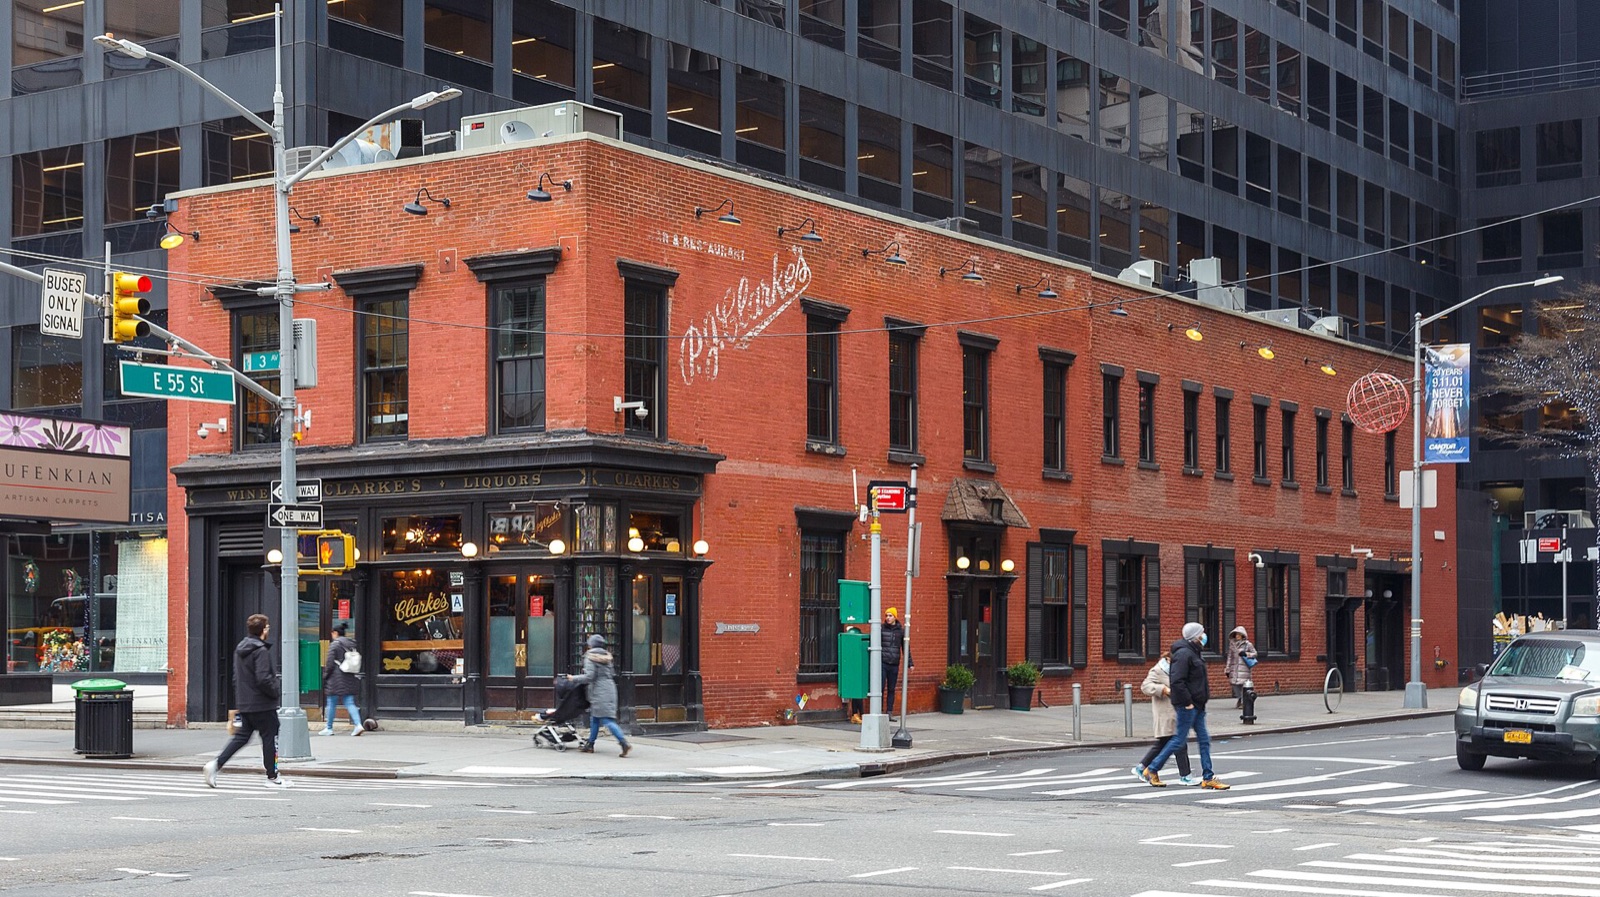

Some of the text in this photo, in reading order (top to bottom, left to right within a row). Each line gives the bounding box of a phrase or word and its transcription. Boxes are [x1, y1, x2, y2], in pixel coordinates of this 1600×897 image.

[47, 275, 81, 293] BUSES
[49, 295, 77, 312] ONLY
[44, 314, 79, 332] SIGNAL
[259, 355, 266, 368] 3
[1441, 368, 1463, 376] YEARS
[153, 372, 204, 394] E 55 St
[1432, 377, 1463, 387] 9.11.01
[1432, 388, 1463, 399] NEVER
[1432, 398, 1463, 409] FORGET
[324, 479, 422, 496] CLARKE'S
[463, 473, 542, 489] LIQUORS
[614, 473, 681, 490] CLARKE'S
[300, 486, 316, 496] WAY
[5, 494, 99, 507] ARTISAN CARPETS
[278, 511, 315, 521] ONE WAY
[394, 592, 449, 621] Clarke's
[453, 596, 462, 608] A
